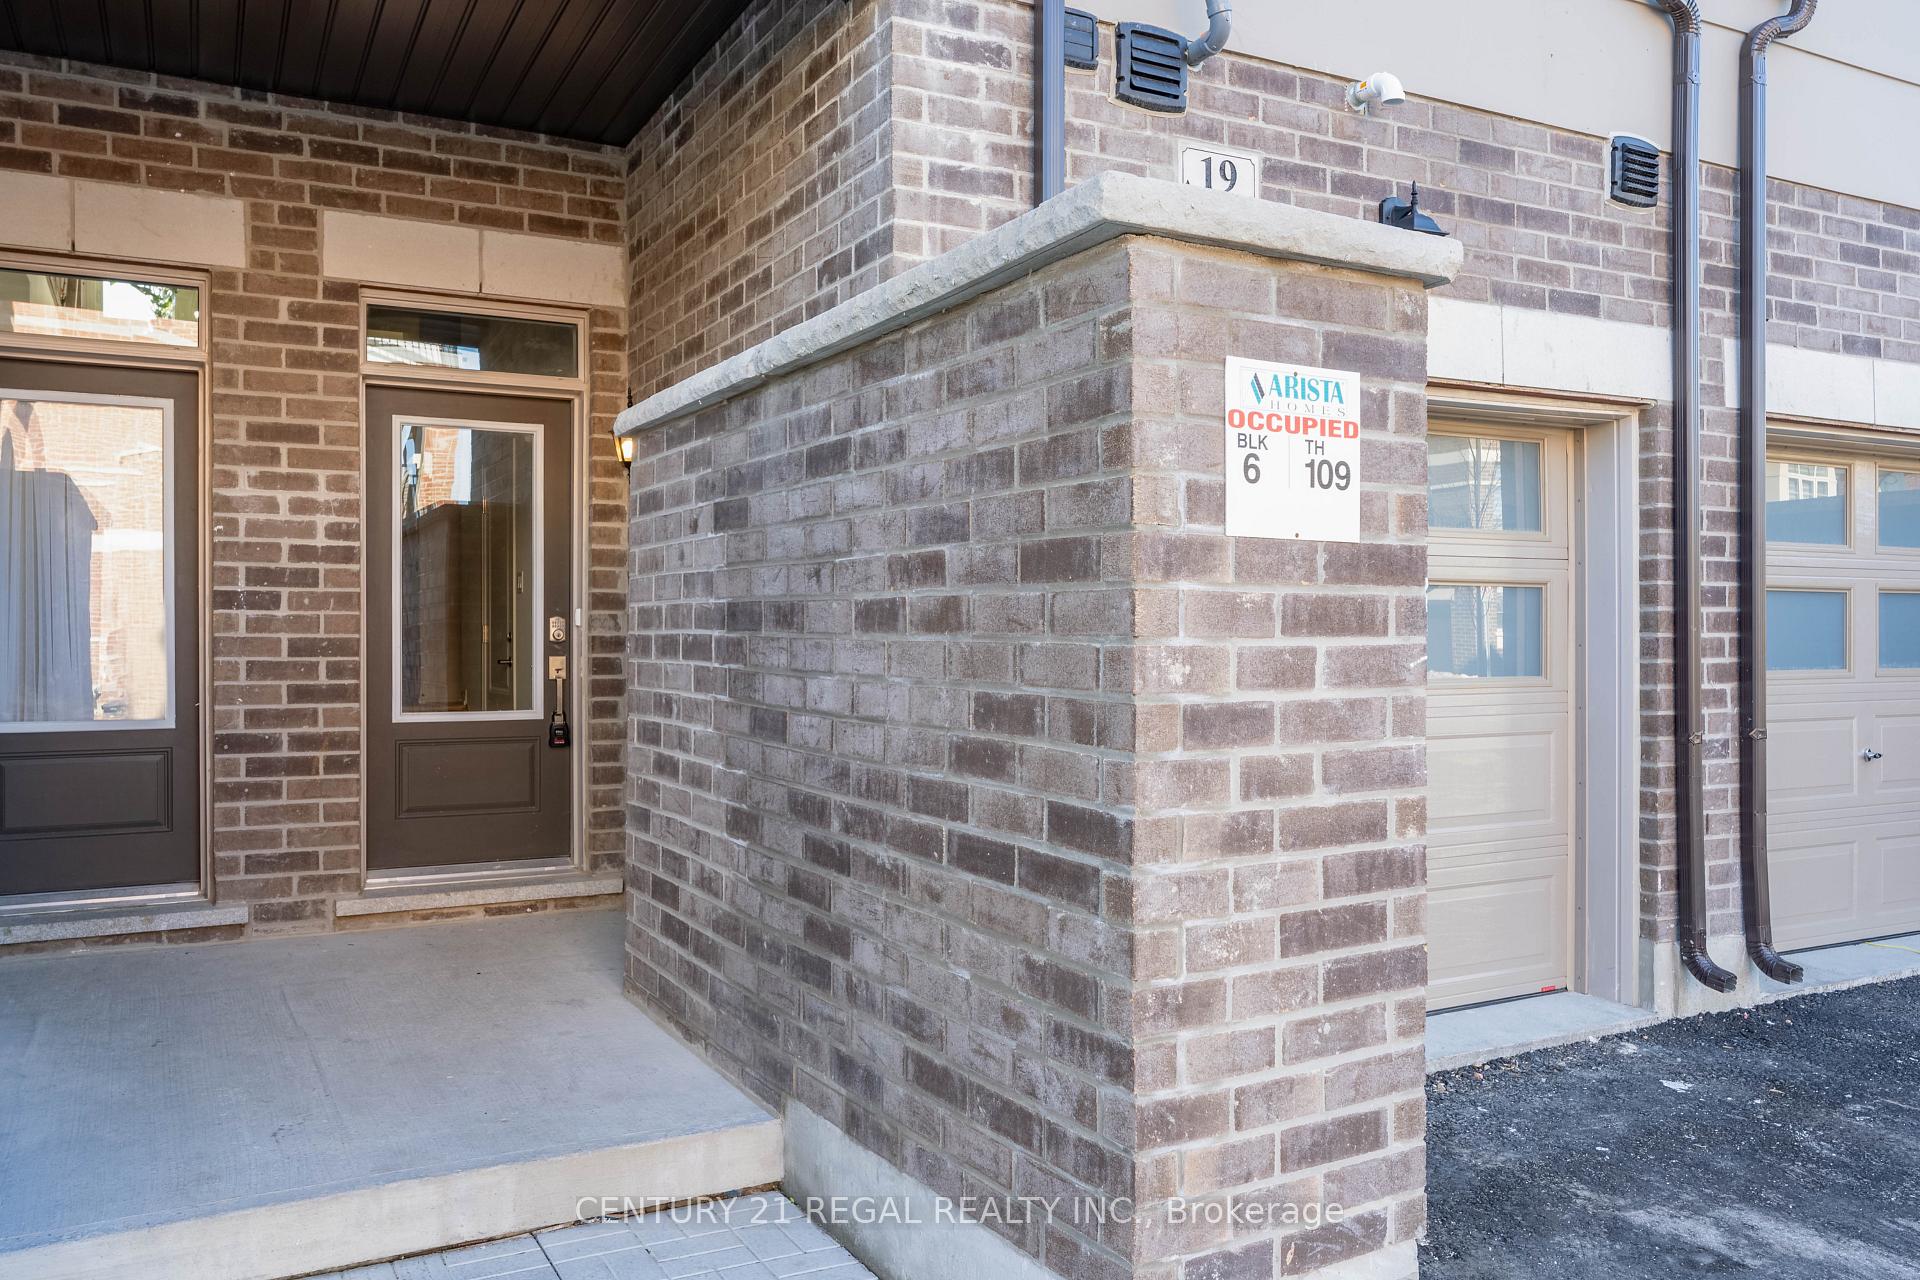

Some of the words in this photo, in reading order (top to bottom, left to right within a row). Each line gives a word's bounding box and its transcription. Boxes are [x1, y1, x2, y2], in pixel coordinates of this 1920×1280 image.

[1201, 157, 1237, 192] 19
[1268, 374, 1344, 404] ARISTA
[1270, 400, 1346, 416] HOMES
[1227, 408, 1359, 439] OCCUPIED
[1237, 433, 1268, 451] BLK
[1304, 439, 1325, 456] TH
[1242, 452, 1261, 484] 6
[1304, 458, 1351, 491] 109
